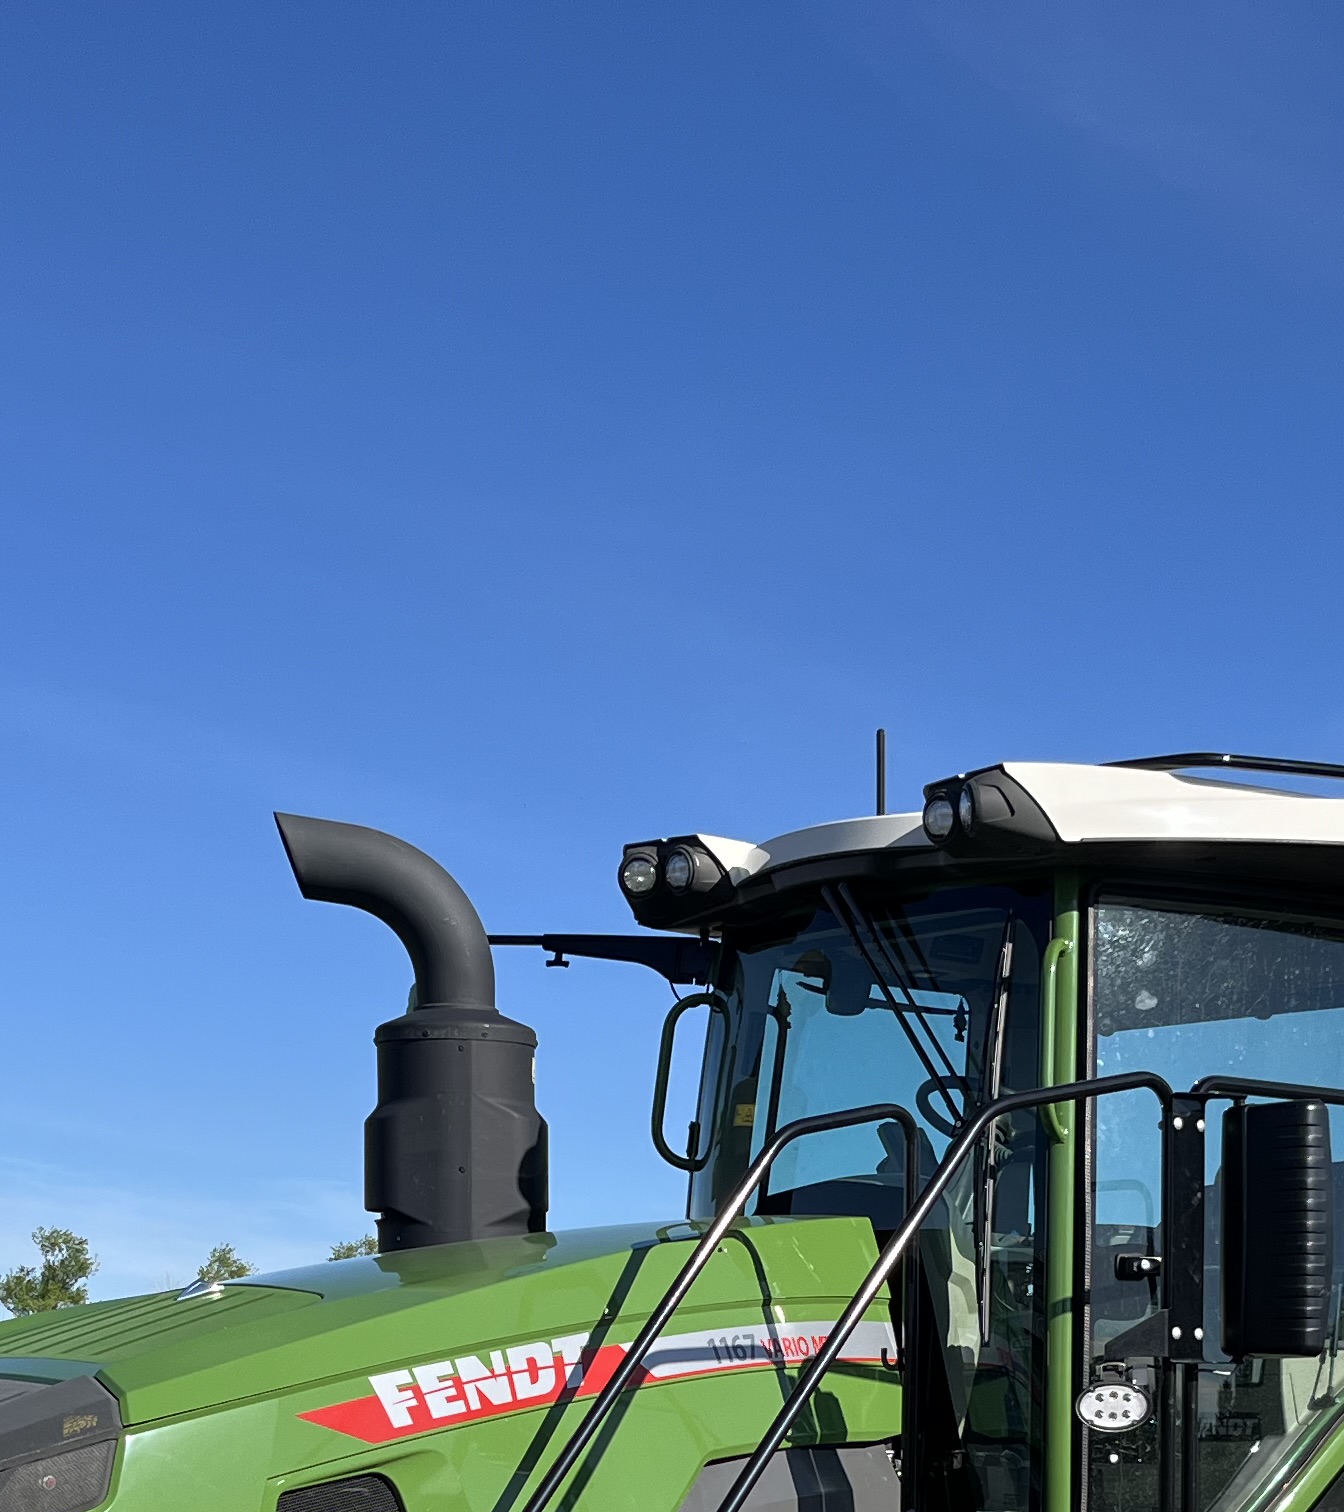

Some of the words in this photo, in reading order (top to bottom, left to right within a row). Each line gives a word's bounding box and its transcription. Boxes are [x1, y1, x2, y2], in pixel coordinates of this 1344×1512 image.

[367, 1331, 590, 1429] FENDT
[706, 1332, 756, 1364] 1167
[760, 1335, 810, 1359] VARIO
